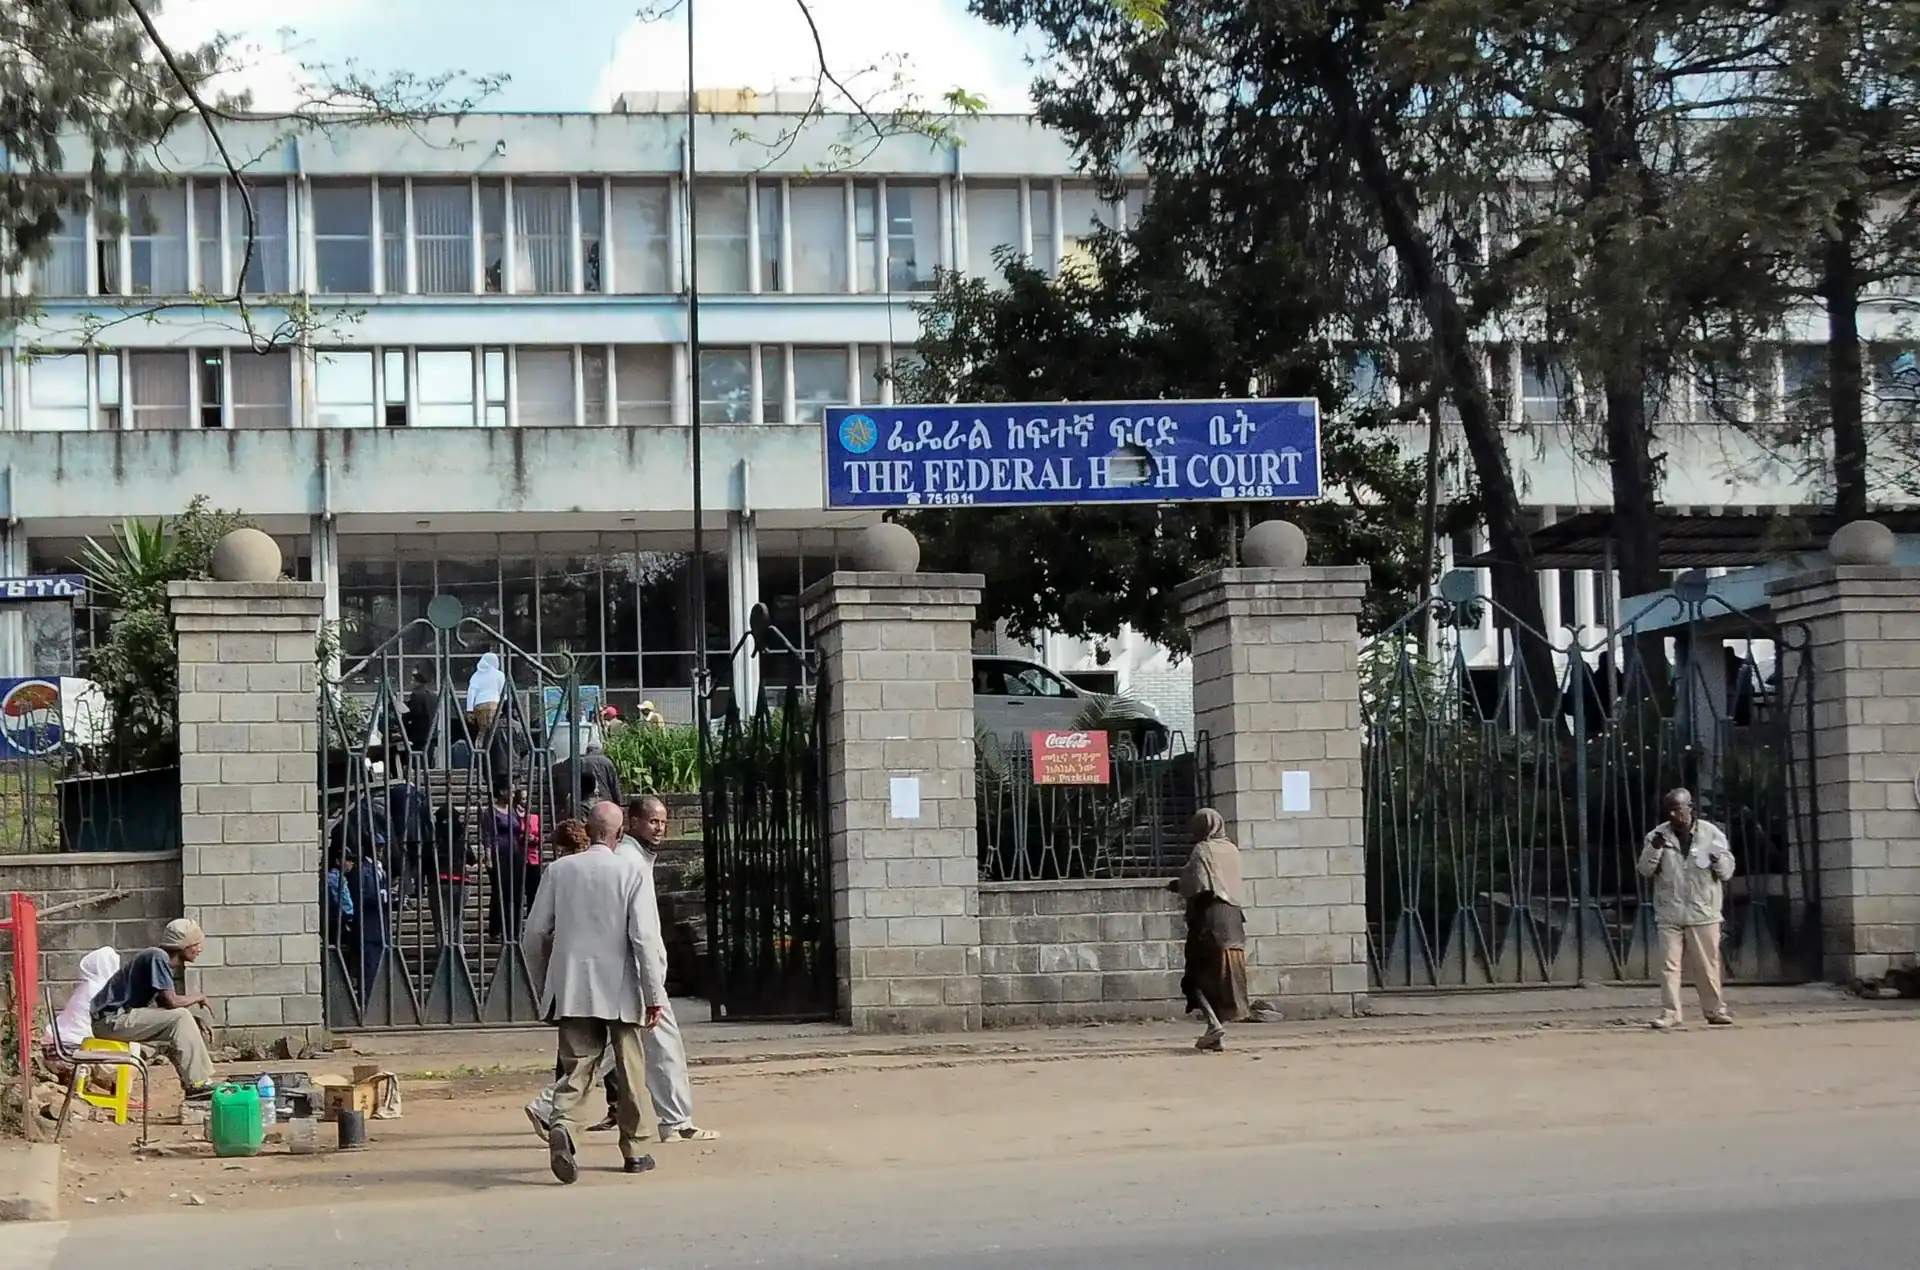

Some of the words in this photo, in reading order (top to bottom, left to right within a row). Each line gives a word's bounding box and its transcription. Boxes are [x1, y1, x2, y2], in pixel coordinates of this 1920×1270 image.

[887, 418, 993, 452] ፌዴራል
[1007, 413, 1095, 449] ከፍተኛ
[1109, 415, 1179, 448] ፍርድ
[1209, 409, 1256, 445] ቤት
[844, 460, 915, 494] THE
[922, 456, 1082, 493] FEDERAL
[1088, 454, 1180, 489] HH
[1186, 451, 1302, 488] COURT
[1237, 484, 1274, 497] 3483
[926, 492, 975, 505] 751911
[1058, 773, 1101, 784] Parking
